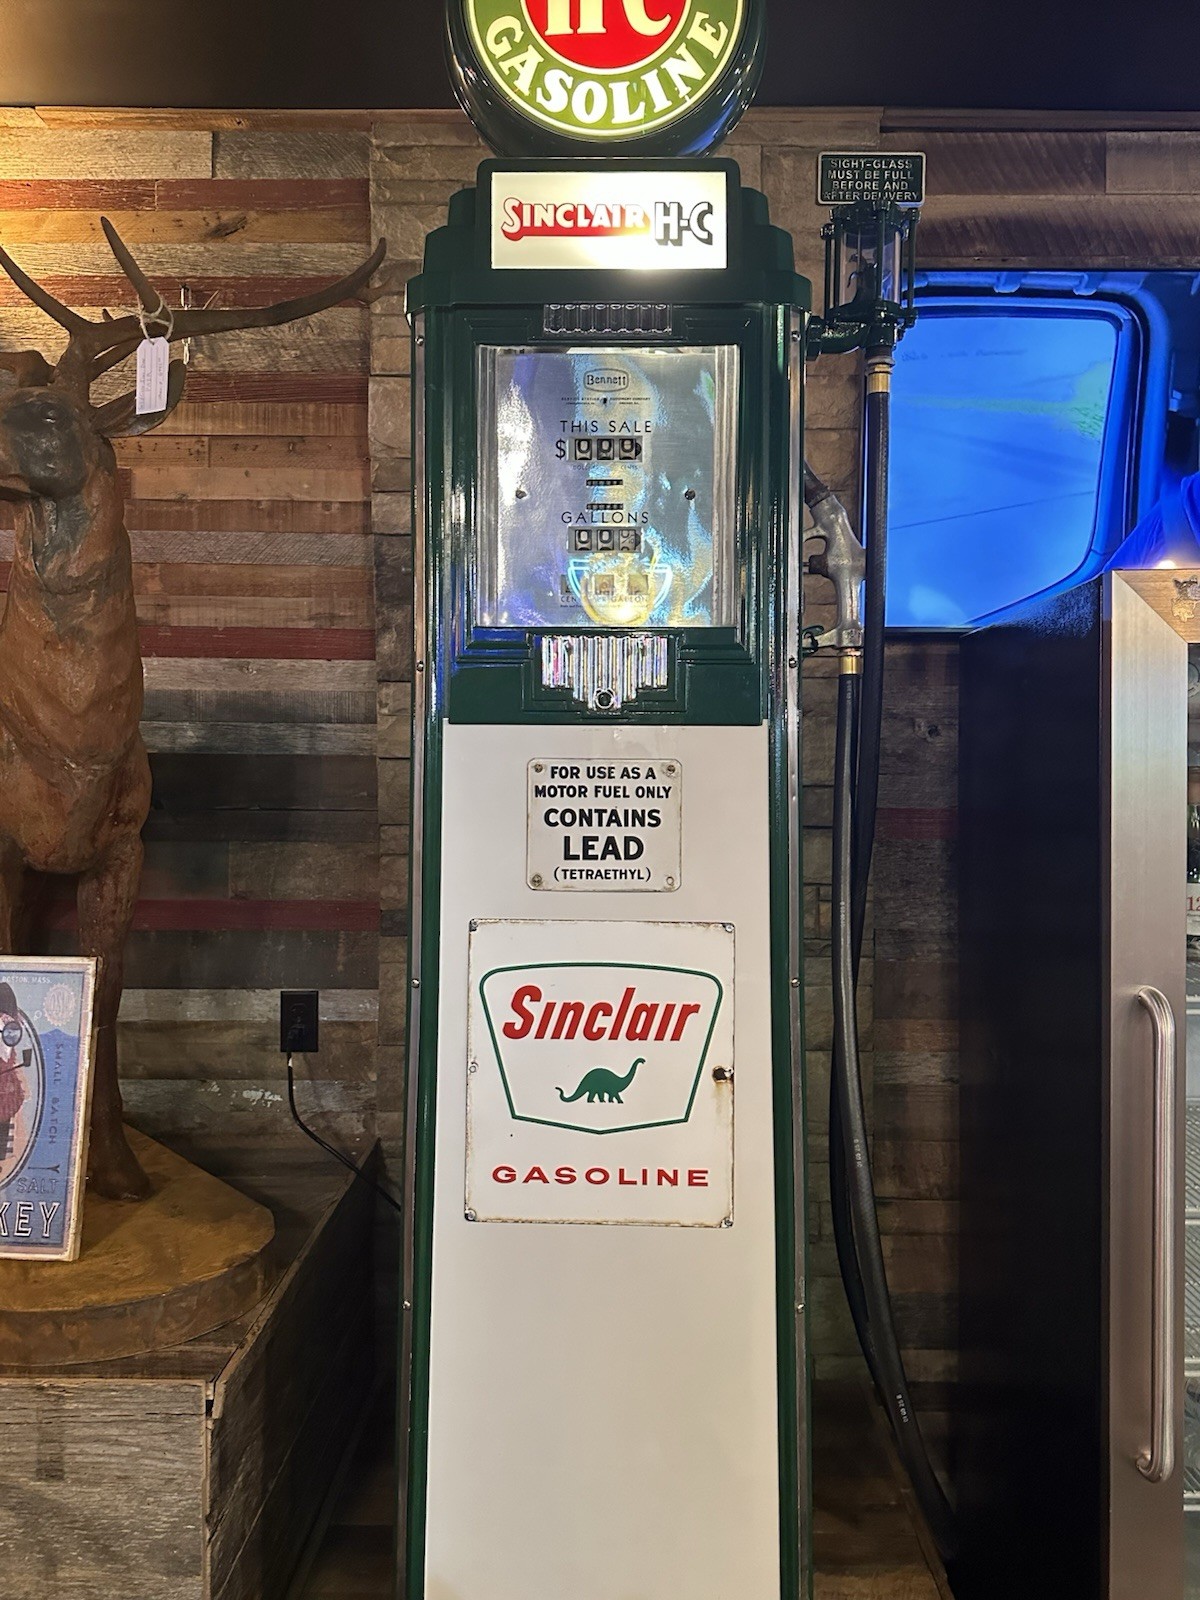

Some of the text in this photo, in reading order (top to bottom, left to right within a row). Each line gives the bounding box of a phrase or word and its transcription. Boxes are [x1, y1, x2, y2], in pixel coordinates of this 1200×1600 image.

[485, 11, 729, 125] GASOLINE
[830, 159, 913, 170] SIGHT-GLASS
[827, 170, 914, 180] MUST BE FULL
[832, 180, 909, 190] BEFORE AND
[823, 191, 919, 201] AFTER DELIVERY
[501, 197, 713, 246] SINCLAIR H-C
[586, 374, 626, 386] Bennett
[560, 420, 652, 433] THIS SALE
[555, 438, 566, 460] $
[561, 511, 649, 524] GALLONS
[550, 766, 657, 779] FOR USE AS A
[534, 785, 672, 799] MOTOR FUEL ONLY
[543, 808, 662, 828] CONTAINS
[563, 835, 645, 861] LEAD
[553, 866, 652, 883] (TETRAETHYL)
[502, 985, 701, 1042] Sinclair
[49, 1043, 64, 1145] SMALL BATCH
[491, 1165, 709, 1187] GASOLINE
[17, 1177, 60, 1194] SALT
